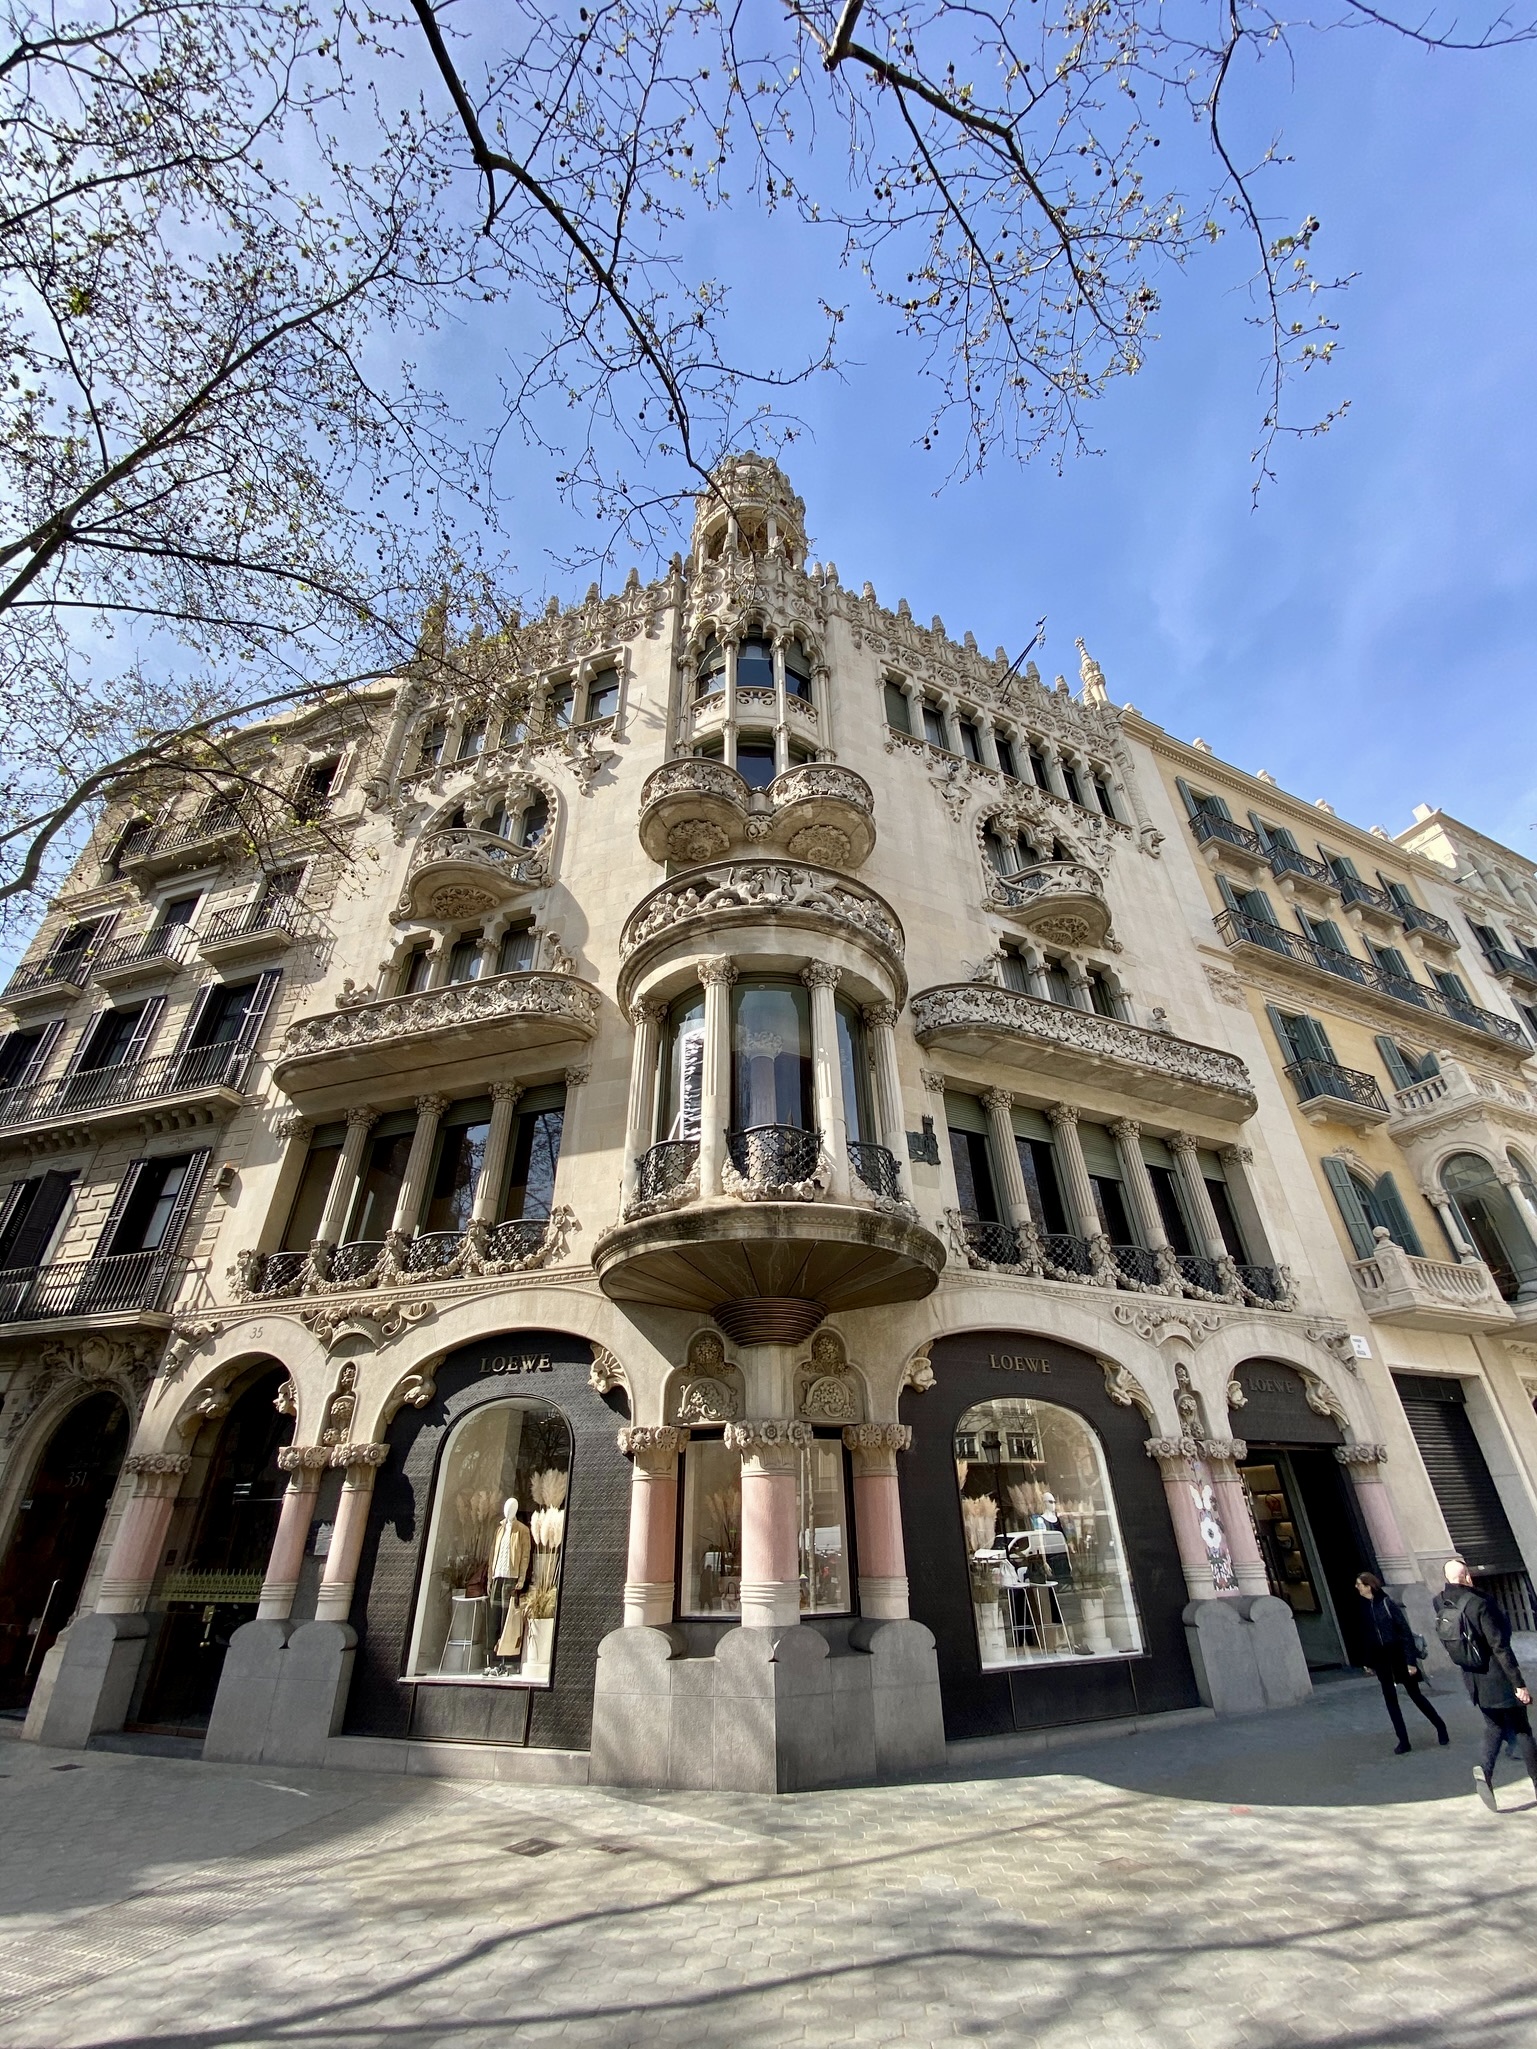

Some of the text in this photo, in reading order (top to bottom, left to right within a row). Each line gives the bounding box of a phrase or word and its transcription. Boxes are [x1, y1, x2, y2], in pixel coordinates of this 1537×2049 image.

[249, 1326, 264, 1339] 35
[479, 1353, 551, 1373] LOEWE
[989, 1354, 1052, 1374] LOEWE
[1247, 1377, 1295, 1394] LOEWE
